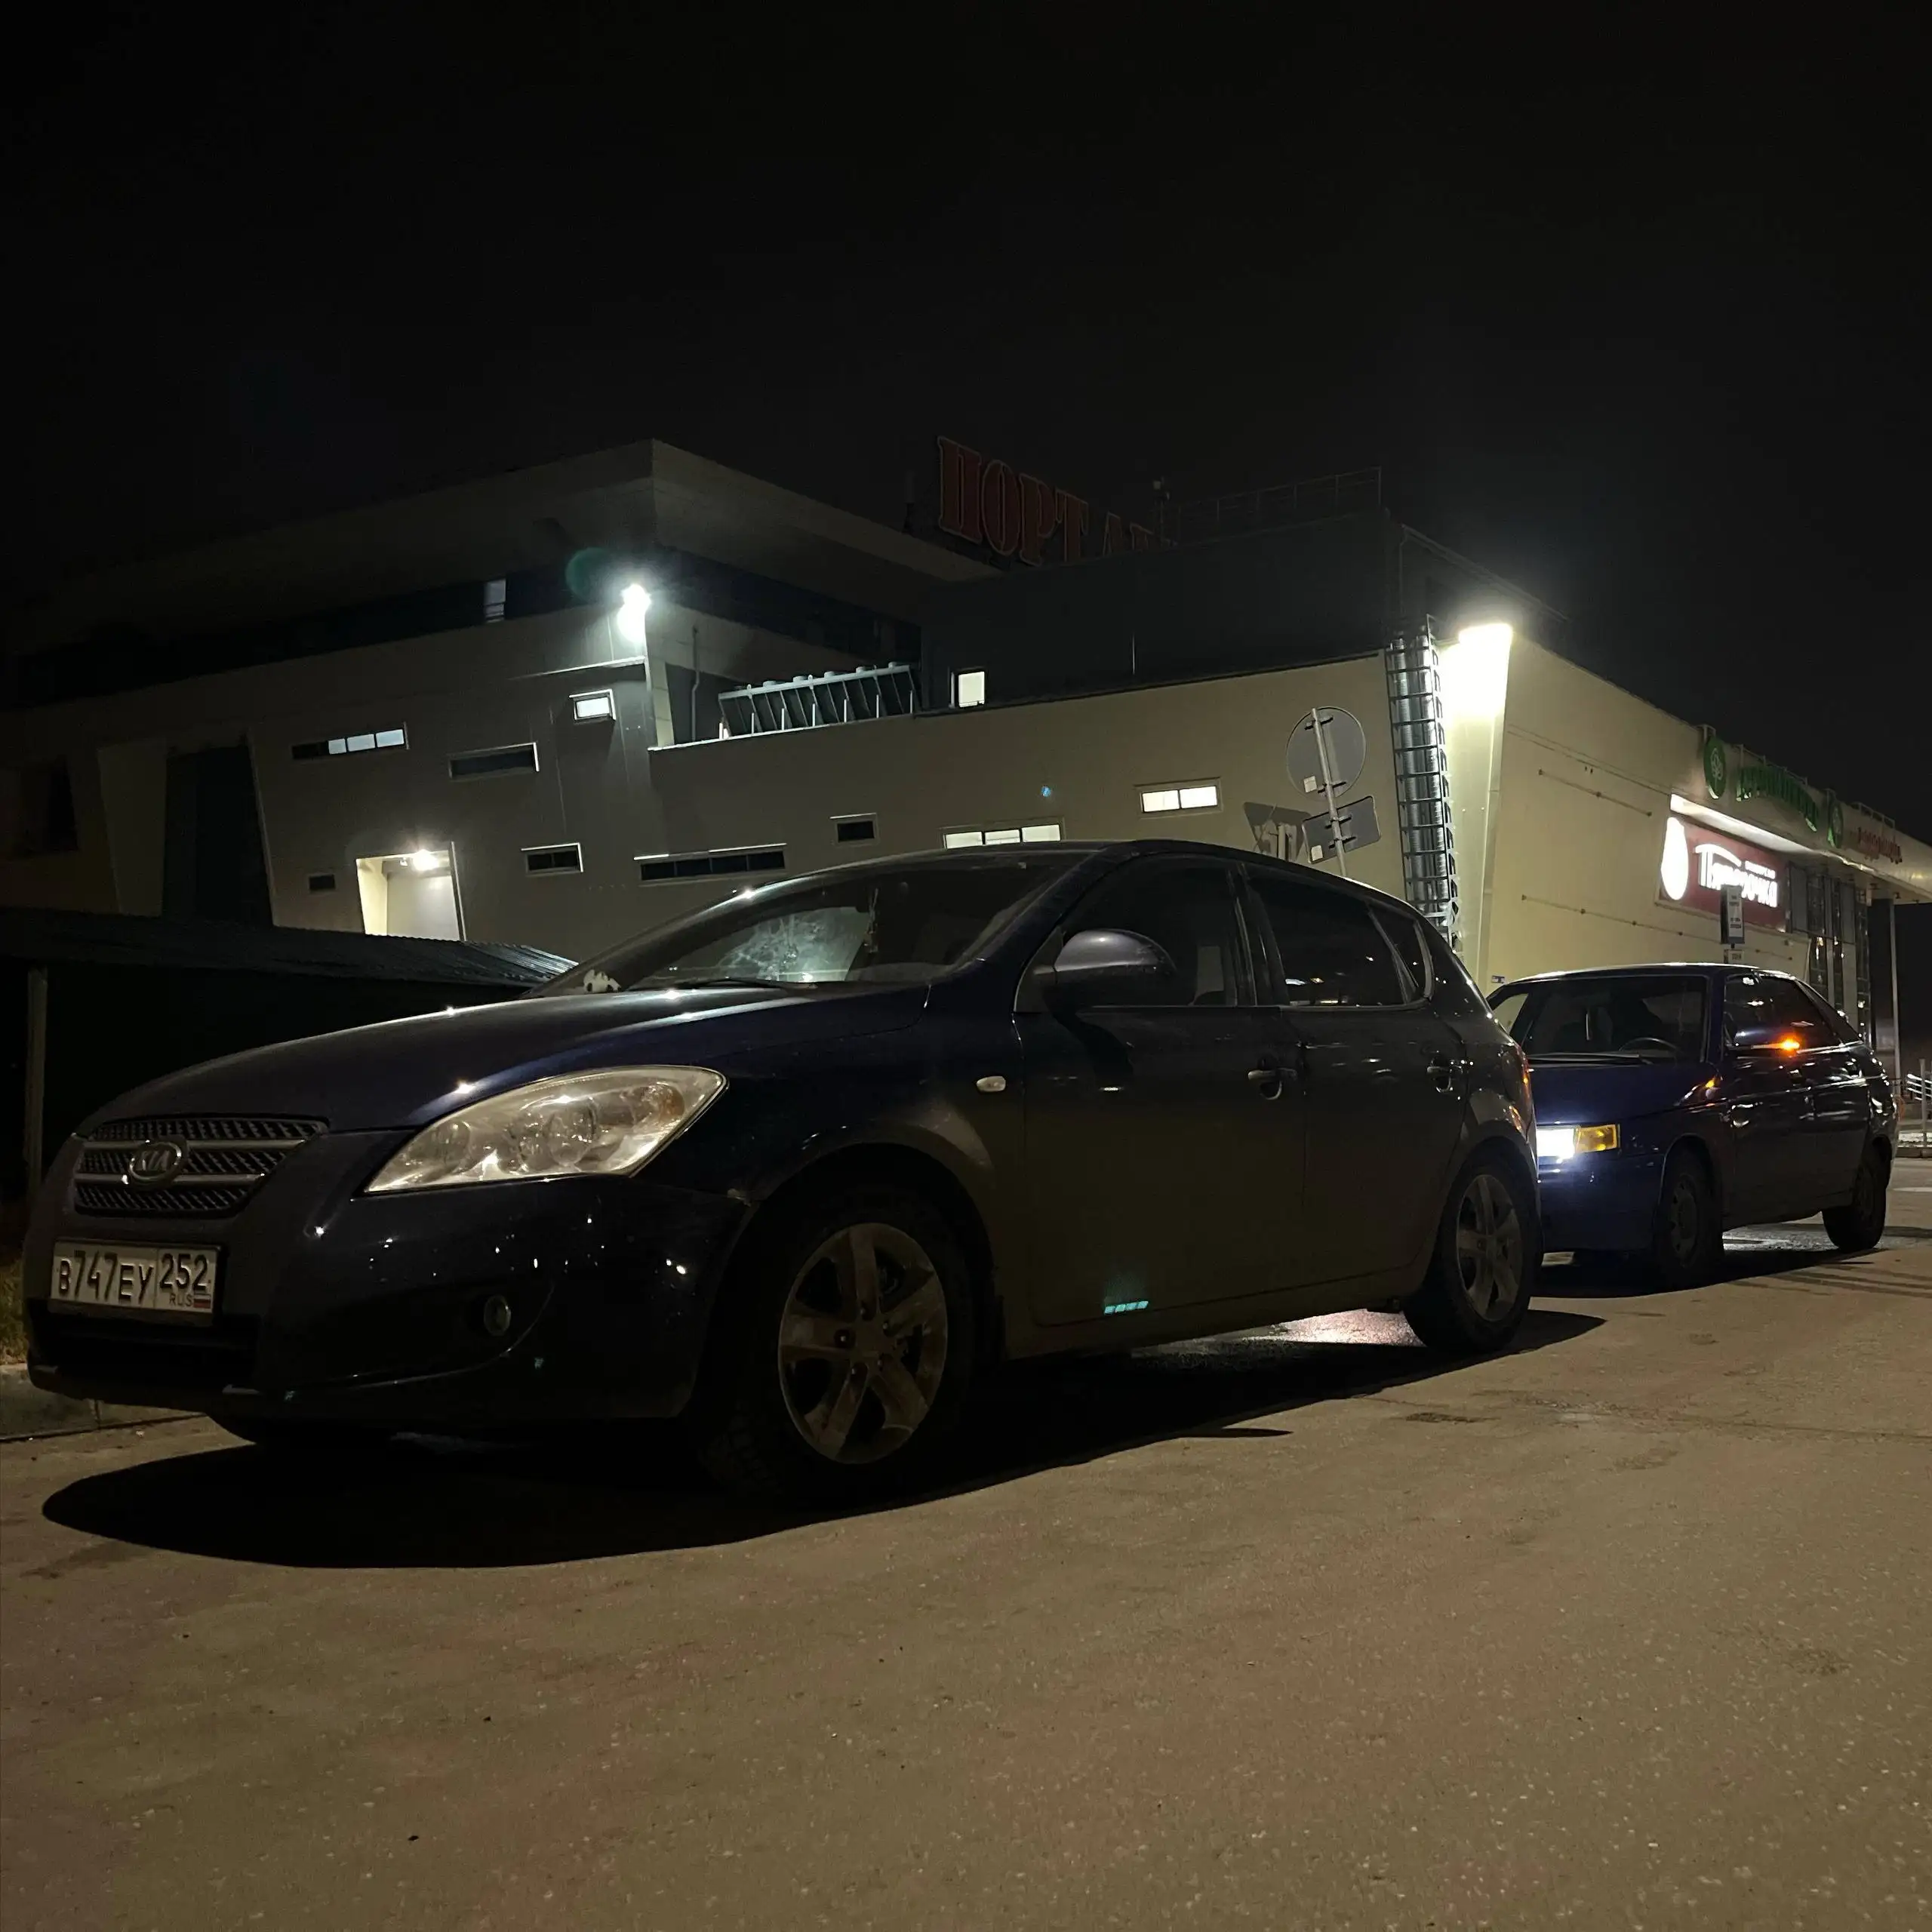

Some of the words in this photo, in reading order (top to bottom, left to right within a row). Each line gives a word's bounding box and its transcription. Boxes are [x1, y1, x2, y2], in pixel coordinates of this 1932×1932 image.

[937, 435, 1089, 567] ПОРТ
[160, 1254, 208, 1291] 252
[169, 1293, 193, 1307] RUS
